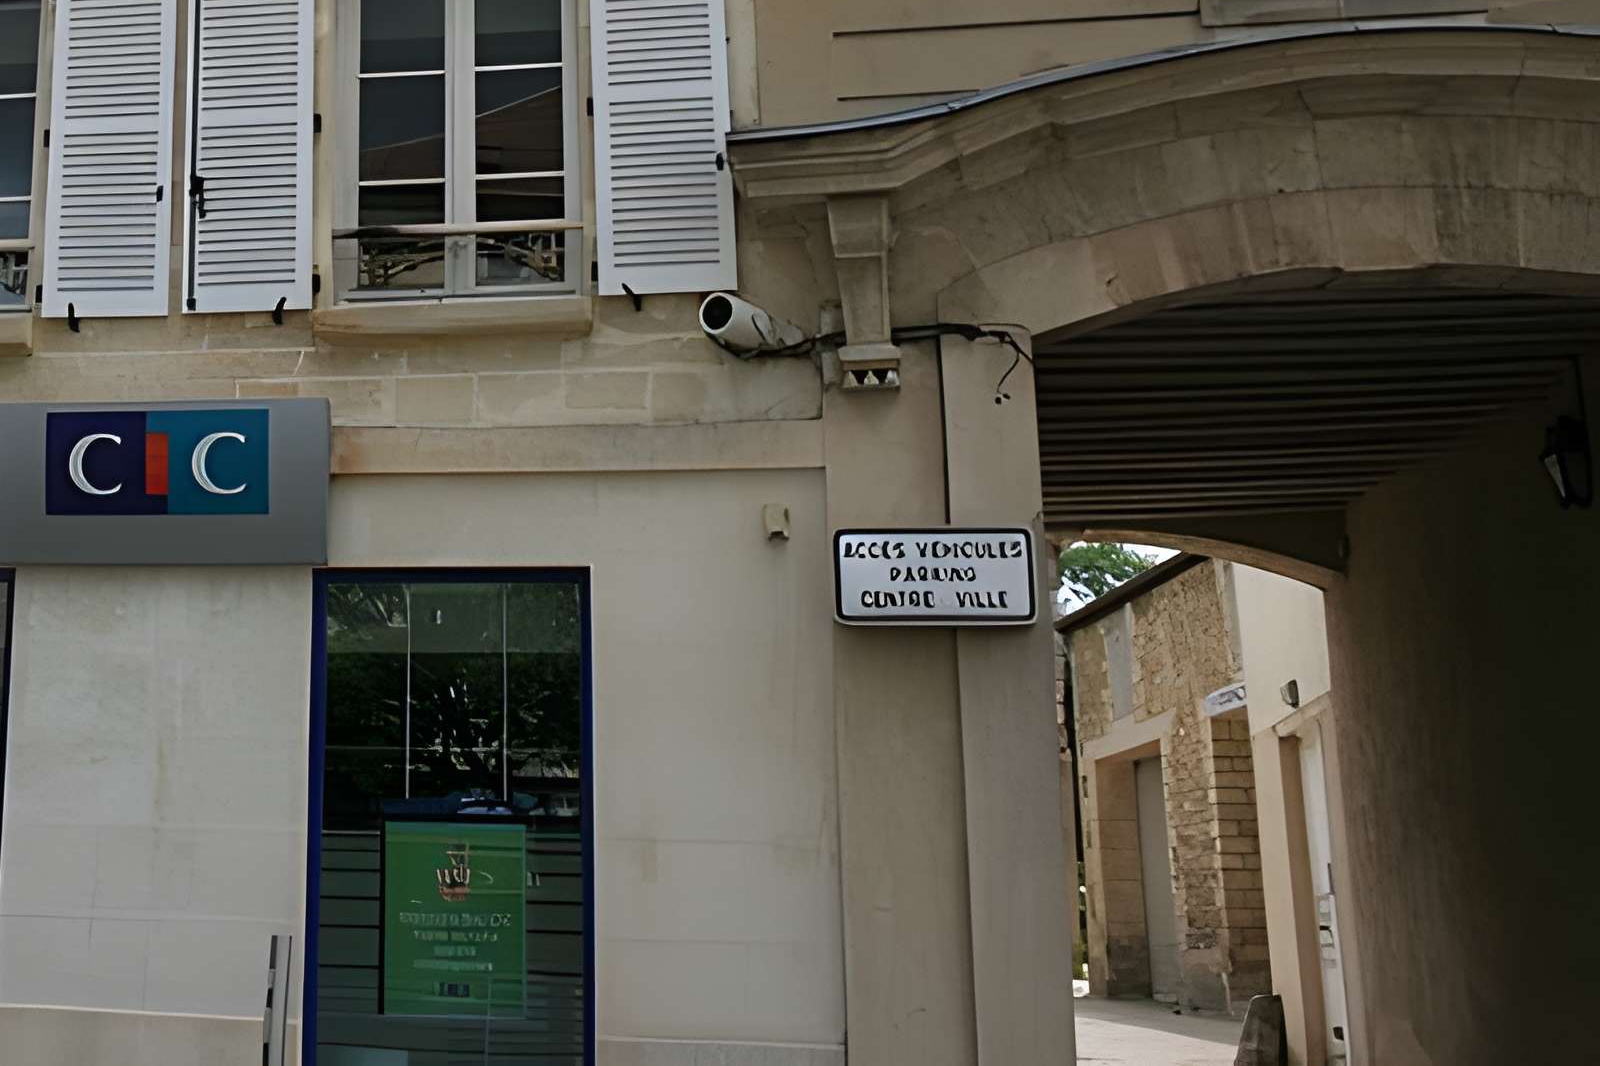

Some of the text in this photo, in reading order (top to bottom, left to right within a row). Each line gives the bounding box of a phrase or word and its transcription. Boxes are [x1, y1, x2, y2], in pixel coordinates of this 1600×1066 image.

[69, 431, 247, 495] CIC
[861, 590, 1008, 608] CENTRE VILLE
